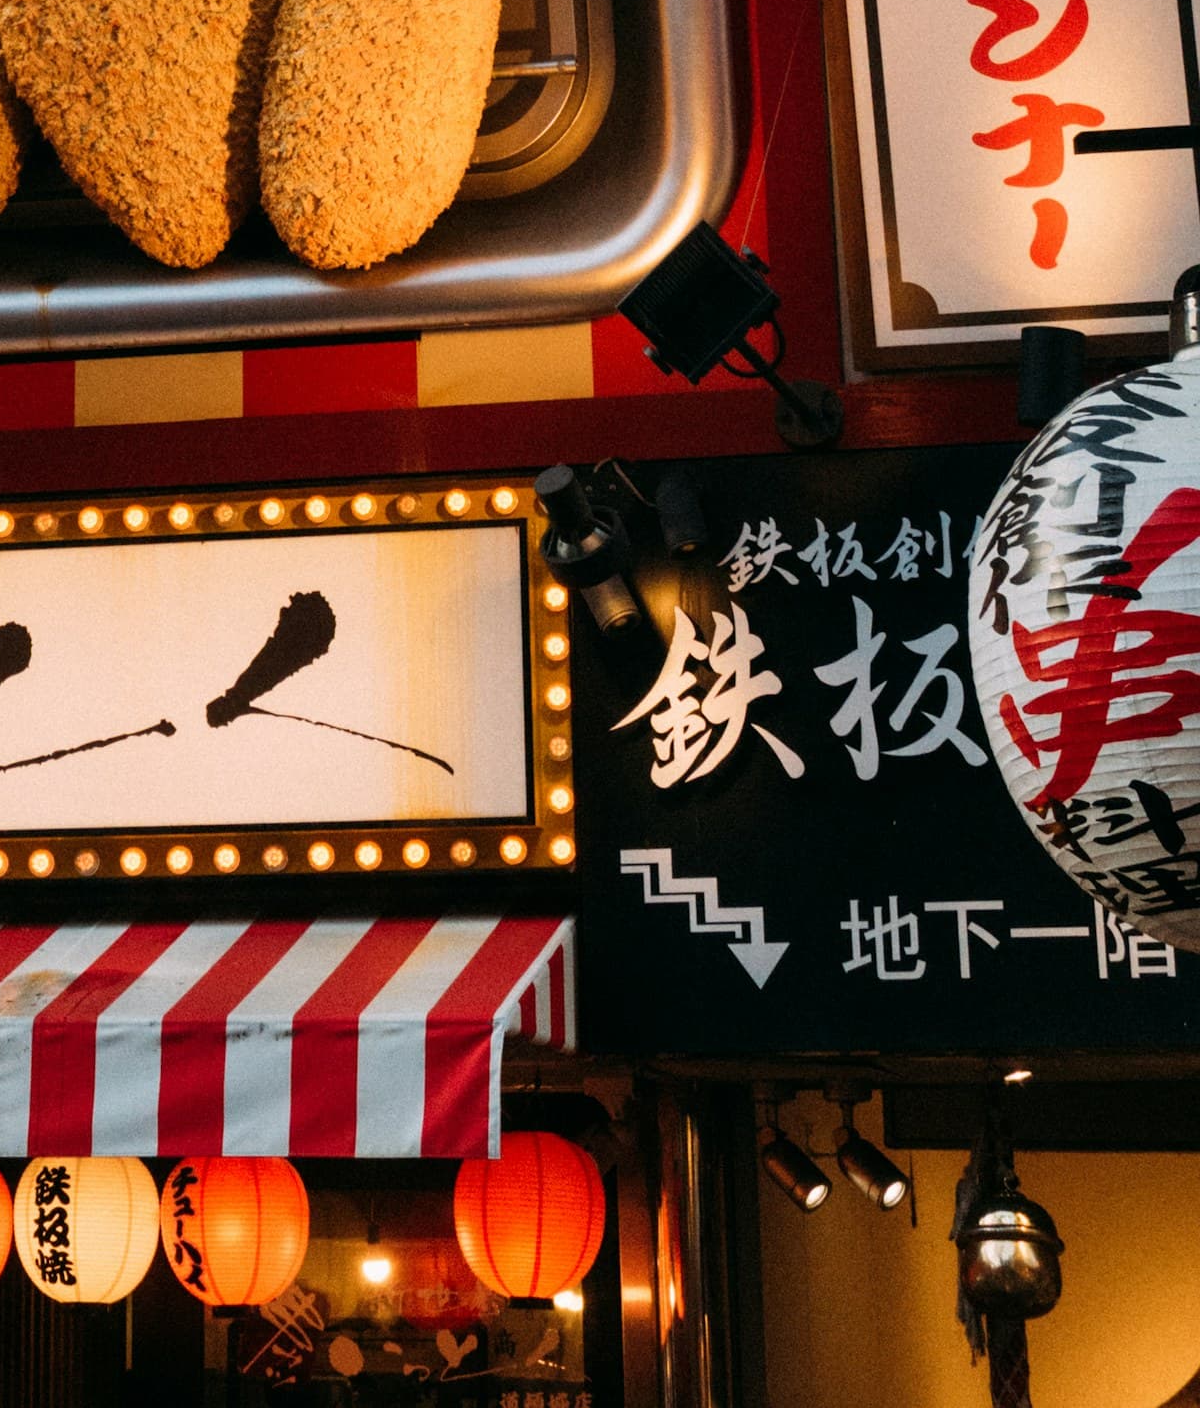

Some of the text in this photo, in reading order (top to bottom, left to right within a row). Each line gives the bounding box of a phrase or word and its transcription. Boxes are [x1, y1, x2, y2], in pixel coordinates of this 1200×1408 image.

[718, 510, 982, 592] 鉄板創
[610, 595, 988, 789] 鉄板
[1000, 488, 1200, 811] 串
[841, 896, 1175, 979] 地下一階
[33, 1166, 77, 1285] 鉄板焼
